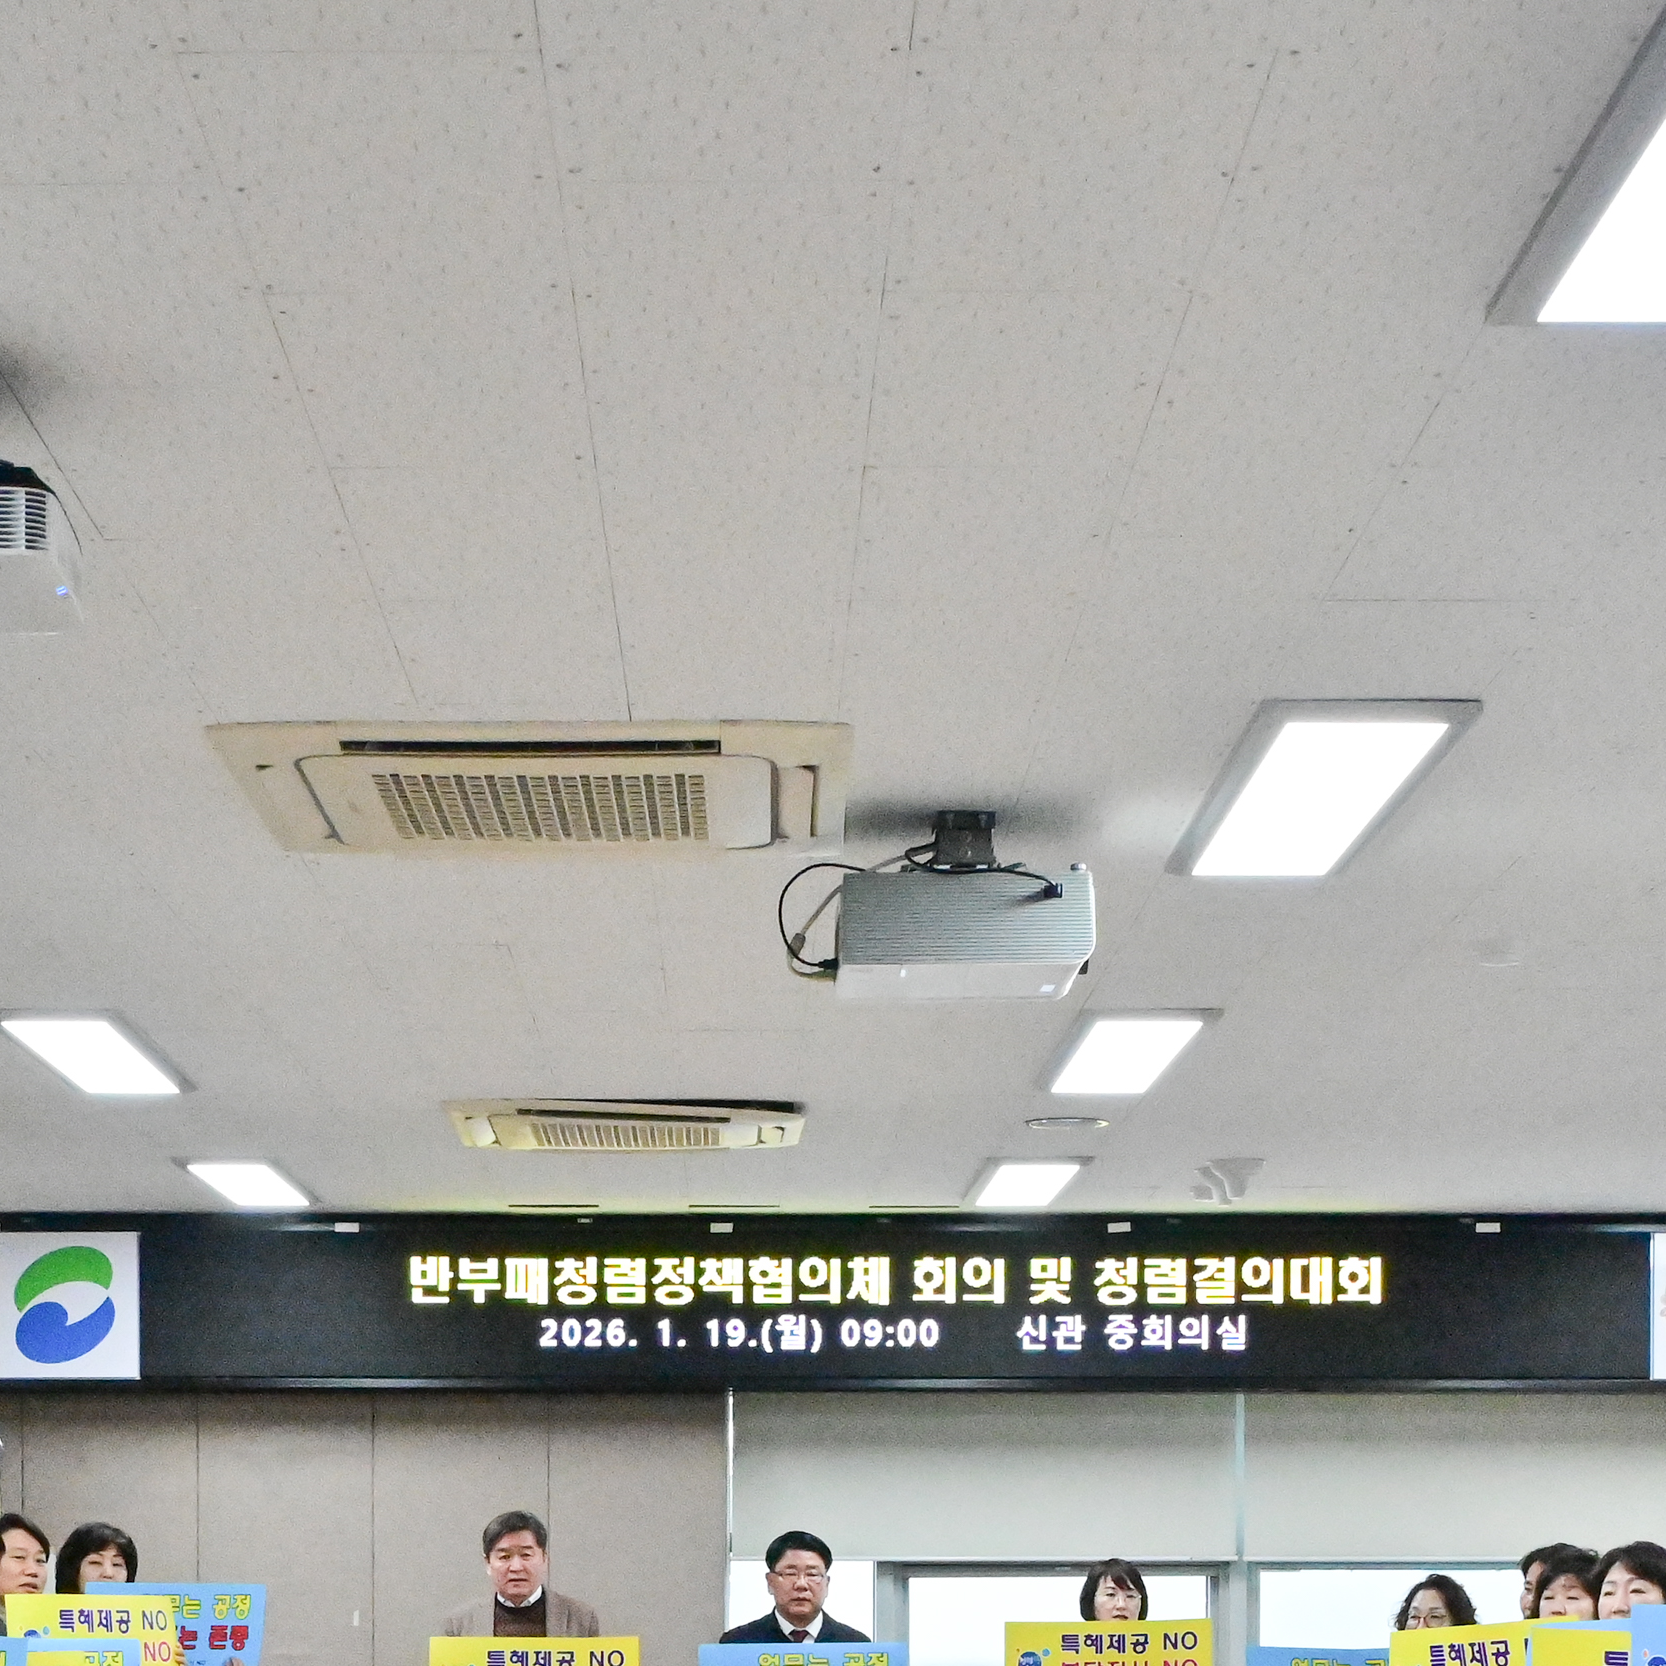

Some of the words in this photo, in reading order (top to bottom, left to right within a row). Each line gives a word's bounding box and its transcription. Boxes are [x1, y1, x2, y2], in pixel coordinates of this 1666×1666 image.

[409, 1255, 891, 1306] 반부패청렴정책협의체
[912, 1256, 1006, 1304] 회의
[1029, 1256, 1073, 1304] 및
[1094, 1256, 1384, 1305] 청렴결의대회
[538, 1318, 638, 1348] 2026.
[656, 1318, 687, 1348] 1.
[706, 1315, 823, 1354] 19.(월)
[840, 1318, 940, 1348] 09:00
[1016, 1314, 1086, 1350] 신관
[1103, 1314, 1248, 1351] 중회의실
[59, 1608, 132, 1634] 특혜제공
[142, 1610, 167, 1631] NO
[144, 1641, 171, 1662] NO
[1061, 1633, 1150, 1655] 특혜제공
[1163, 1631, 1199, 1651] NO
